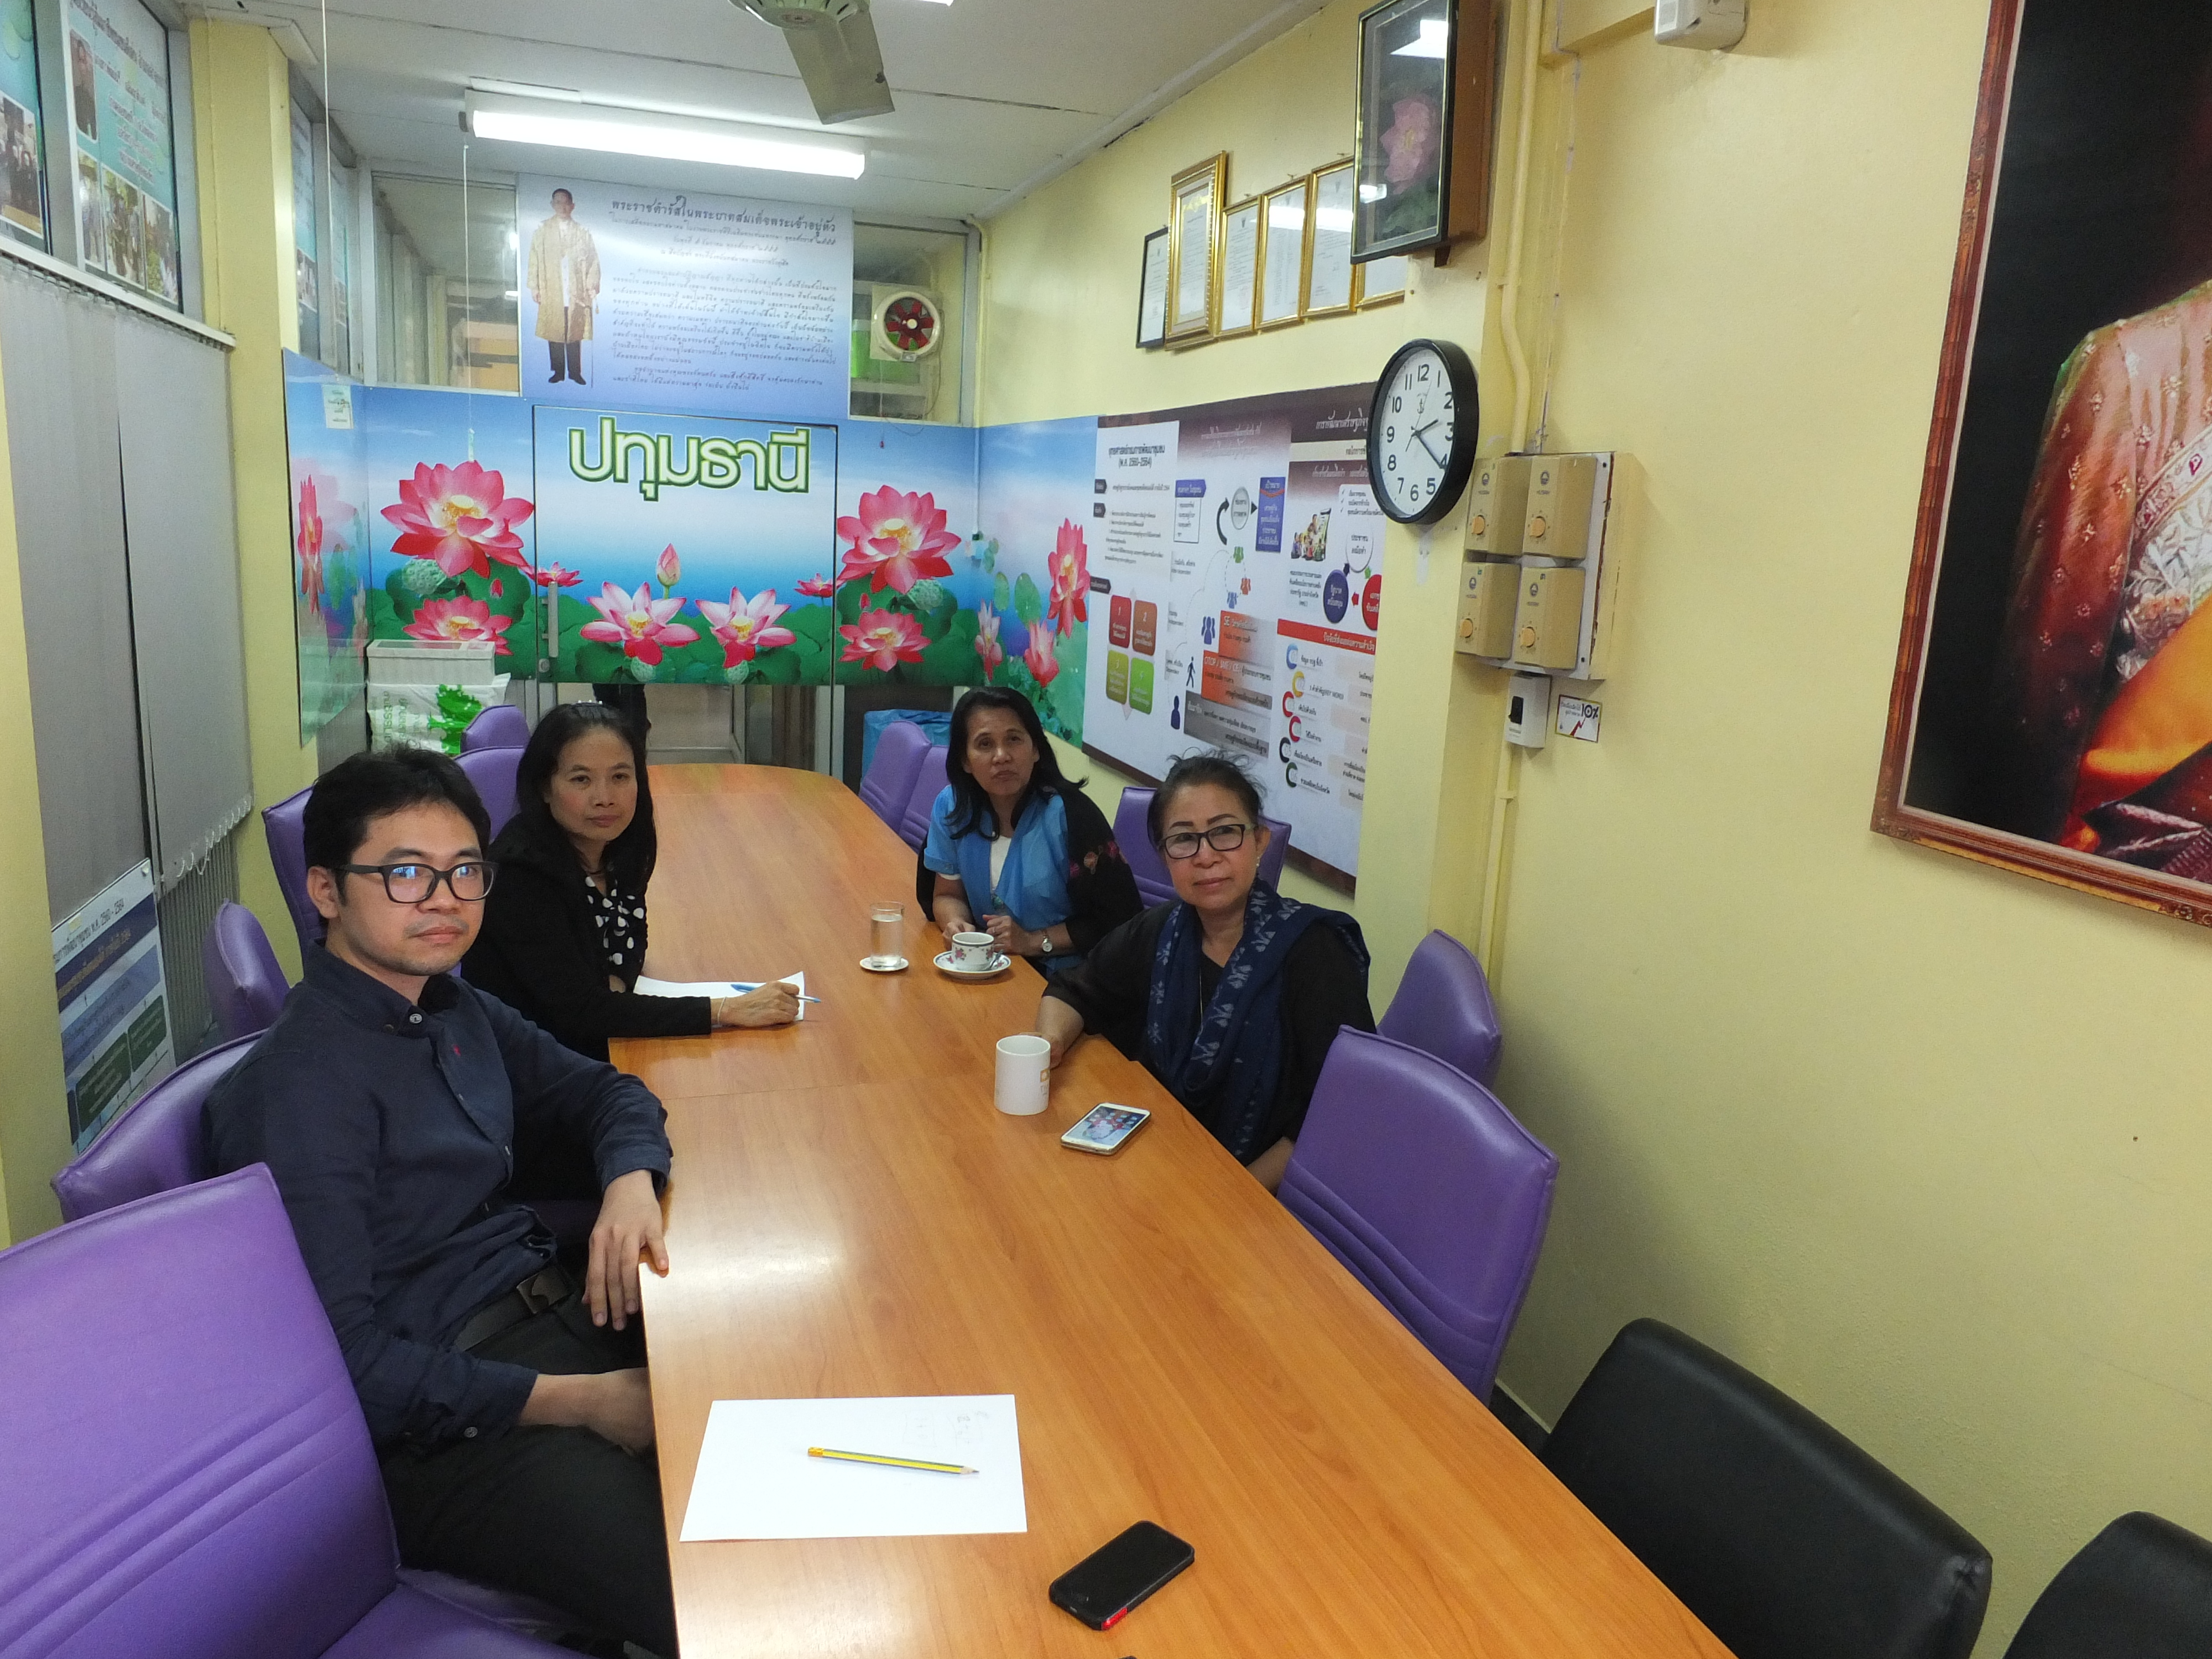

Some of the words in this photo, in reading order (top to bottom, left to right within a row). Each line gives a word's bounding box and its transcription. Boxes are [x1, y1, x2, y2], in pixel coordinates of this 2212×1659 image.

[1405, 373, 1412, 390] 11
[1417, 364, 1430, 382] 12
[1437, 370, 1441, 388] 1
[1391, 396, 1402, 413] 10
[1443, 392, 1453, 409] 2
[1386, 425, 1395, 442] 9
[1444, 422, 1453, 441] 3
[568, 415, 811, 502] ปทุมธานี
[1387, 454, 1396, 471] 8
[1440, 453, 1449, 469] 4
[1397, 477, 1404, 494] 7
[1410, 484, 1418, 502] 6
[1426, 478, 1436, 495] 5
[1581, 703, 1599, 719] 10%
